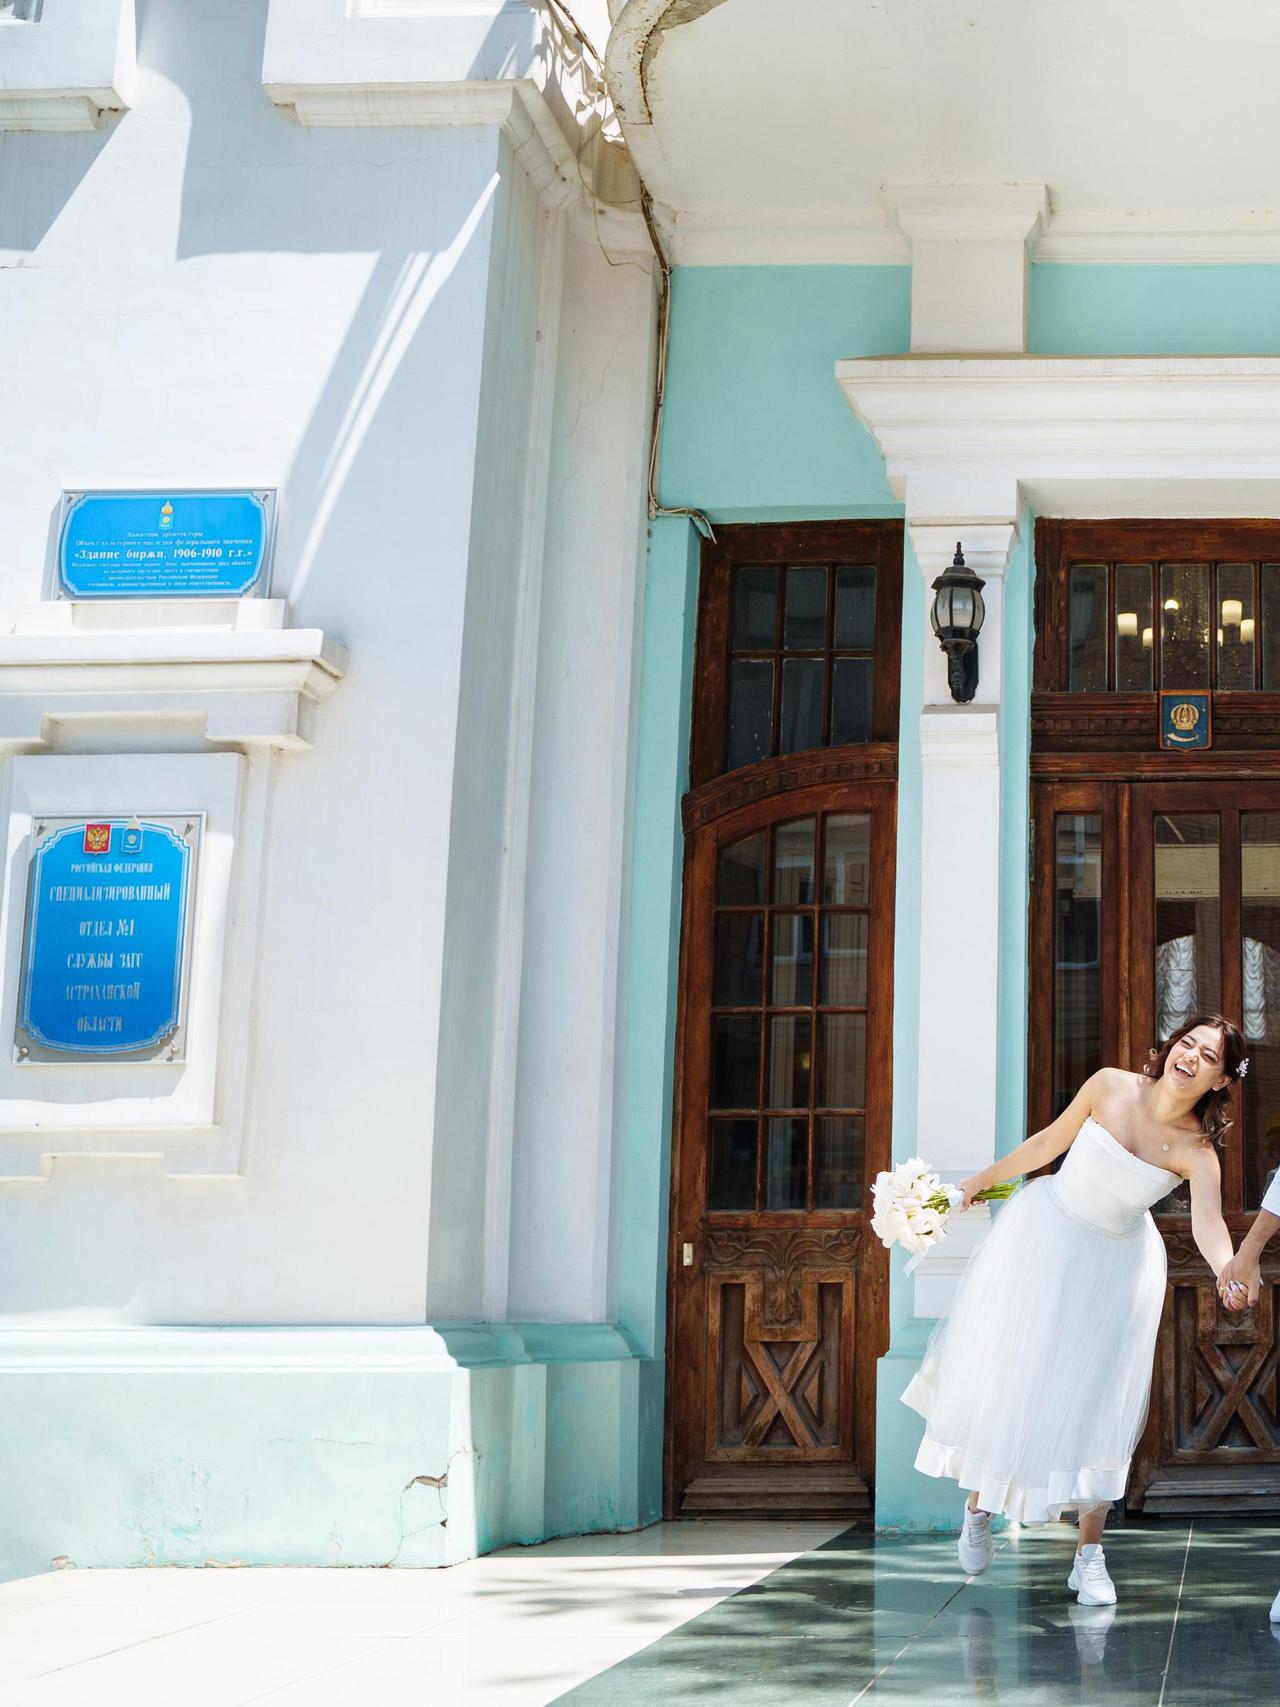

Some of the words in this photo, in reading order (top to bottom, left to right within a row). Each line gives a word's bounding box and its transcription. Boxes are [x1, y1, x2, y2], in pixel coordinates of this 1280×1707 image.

[74, 549, 119, 560] «Здание
[127, 549, 167, 560] биржи,
[173, 548, 222, 558] 1906-1910
[71, 863, 112, 873] РОССИЙСКАЯ
[114, 863, 153, 873] ФЕДЕРАЦИЯ
[50, 882, 170, 902] СПЕЦИАЛИЗИРОВАННЫЙ
[79, 921, 112, 937] ОТДЕЛ
[117, 919, 134, 936] №1
[67, 953, 113, 968] СЛУЖБЫ
[119, 953, 143, 968] ЗАГС
[65, 982, 140, 1000] АСТРАХАНСКОЙ
[77, 1016, 122, 1031] ОБЛАСТИ
